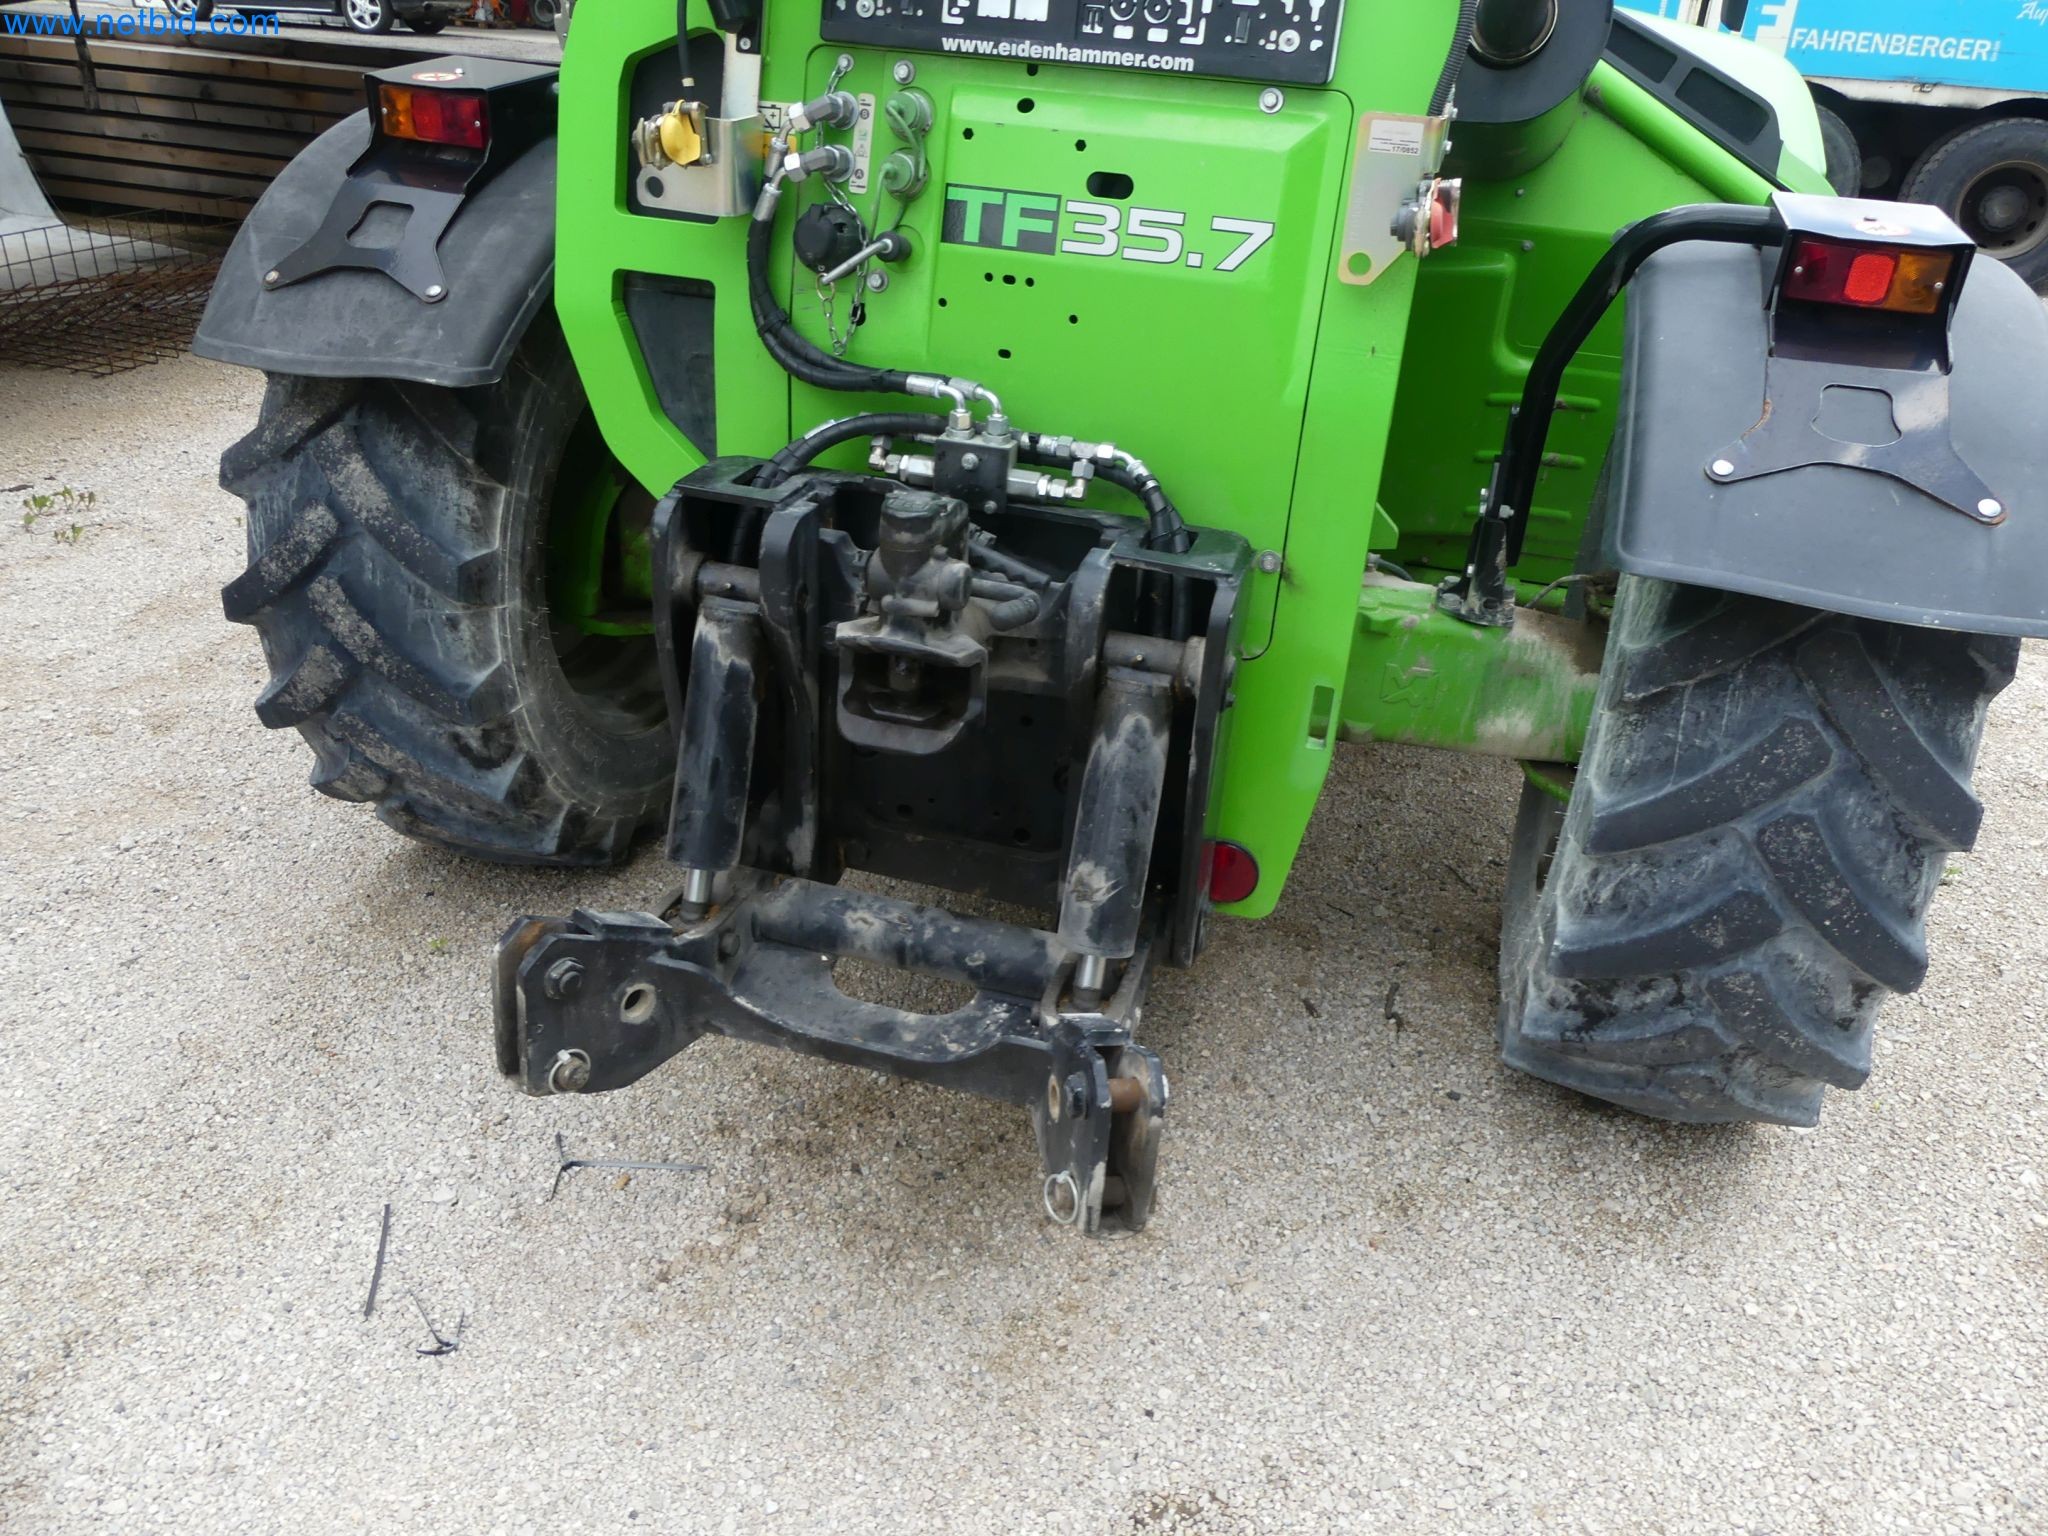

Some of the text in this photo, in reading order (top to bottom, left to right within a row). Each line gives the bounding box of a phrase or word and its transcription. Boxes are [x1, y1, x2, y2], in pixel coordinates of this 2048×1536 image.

[941, 37, 1194, 71] www.eidenhammer.com
[1791, 28, 1990, 62] FAHRENBERGER
[945, 186, 1275, 272] TF35.7
